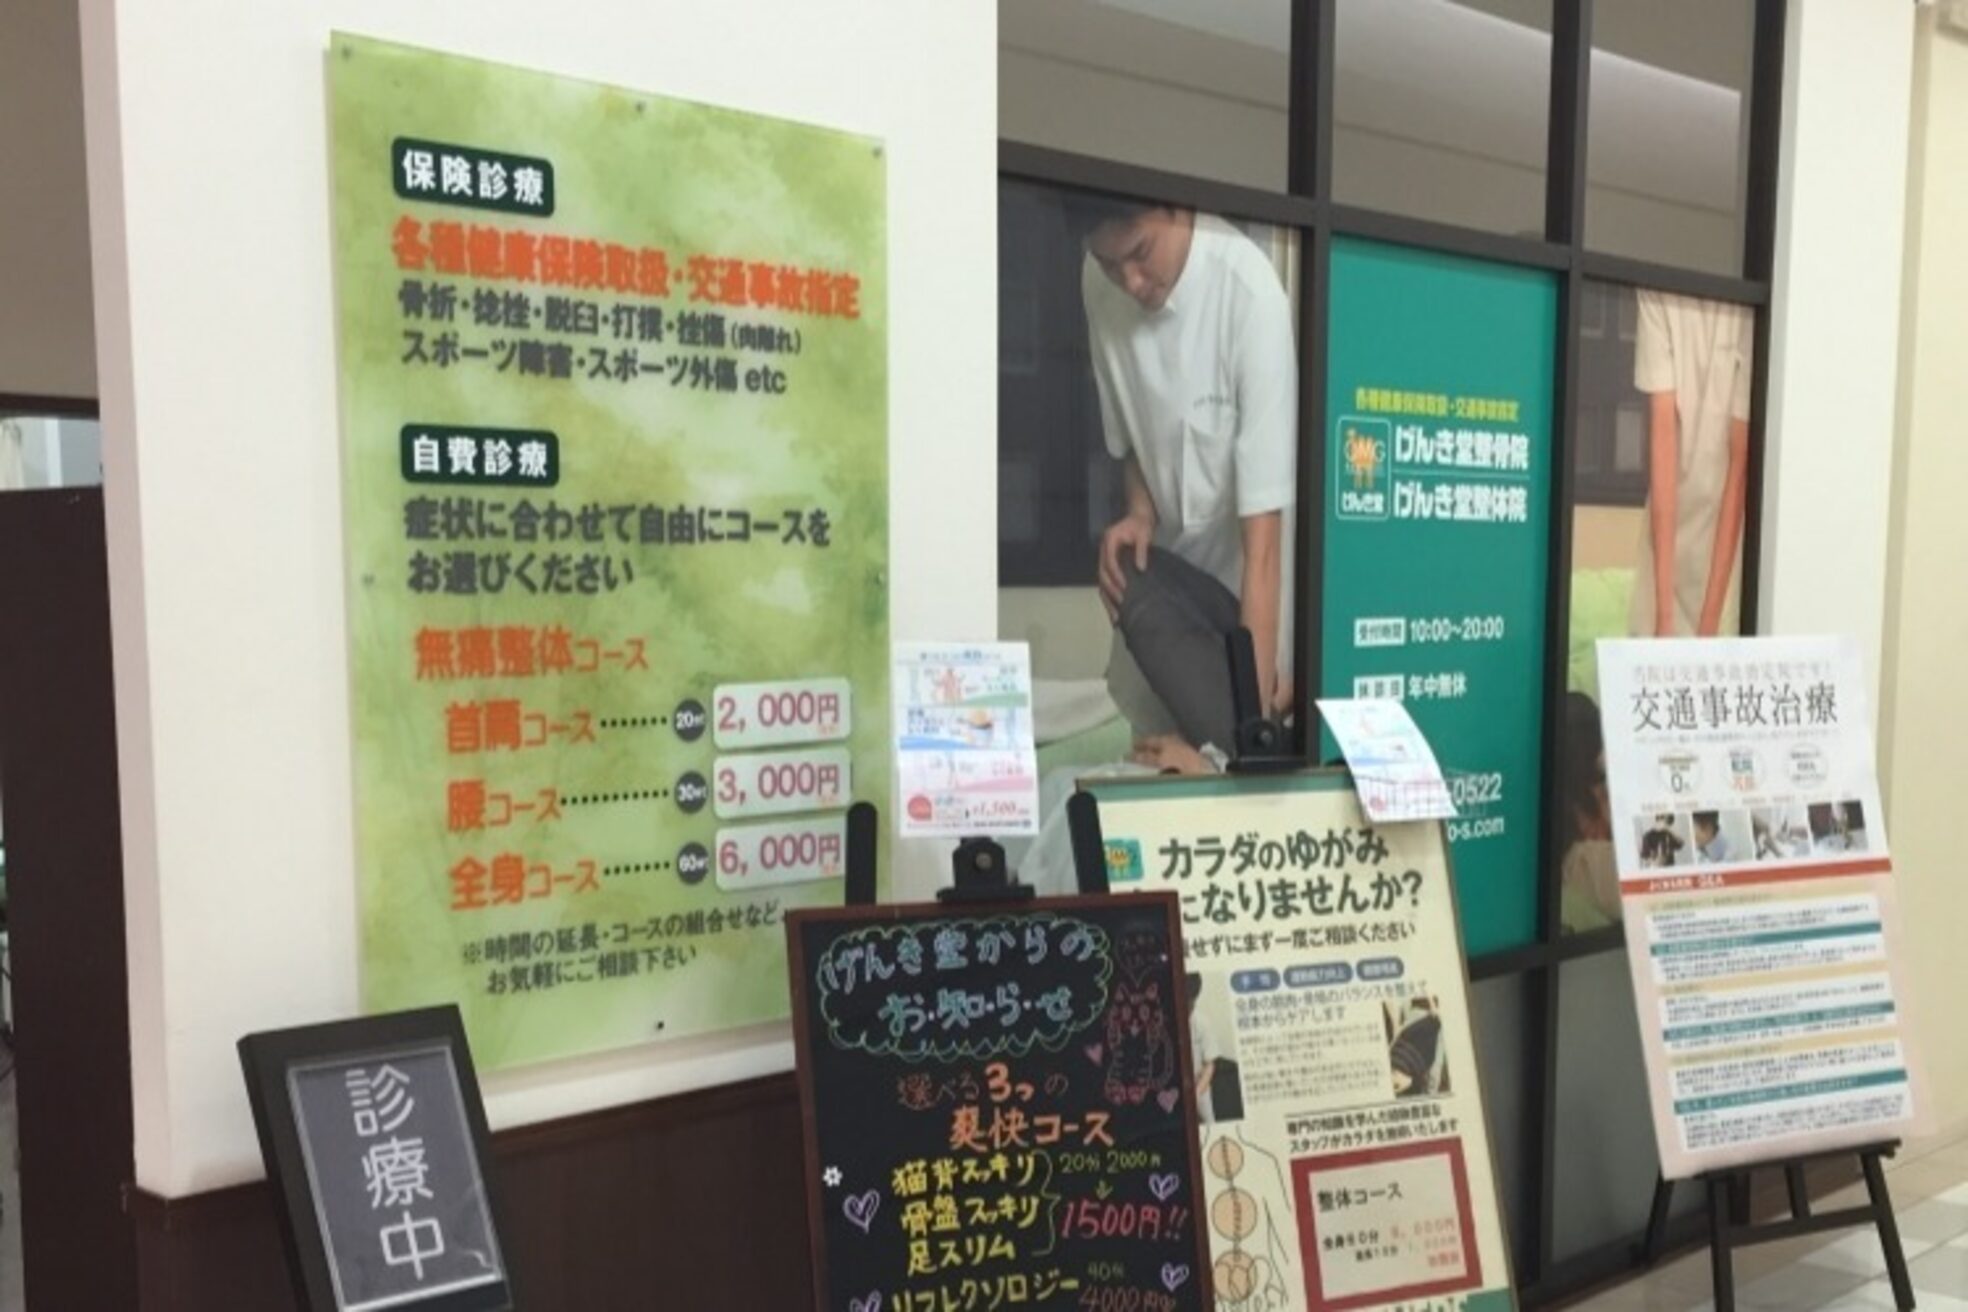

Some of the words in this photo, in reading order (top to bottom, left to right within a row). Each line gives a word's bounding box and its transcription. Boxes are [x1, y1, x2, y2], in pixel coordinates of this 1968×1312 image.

[402, 148, 545, 205] 保険診療
[745, 365, 787, 395] etc
[412, 434, 548, 478] 自費診療
[403, 496, 831, 547] 症状に合わせて自由にコースを
[407, 551, 635, 594] お選びください
[413, 626, 650, 680] 無痛整体コース
[1408, 671, 1467, 699] 年中無休
[1630, 681, 1839, 732] 交通事故治療
[445, 698, 597, 754] 首肩コース
[447, 778, 562, 833] 腰コース
[1158, 828, 1390, 880] カラダのゆがみ
[450, 852, 600, 911] 全身コース
[948, 1106, 1116, 1154] 爽快コース
[345, 1063, 445, 1281] 診療中
[891, 1152, 1037, 1198] 猫背スッキリ
[900, 1194, 1040, 1239] 骨盤スッキリ
[1316, 1182, 1404, 1213] 整体コース
[907, 1235, 1016, 1278] 足スリム
